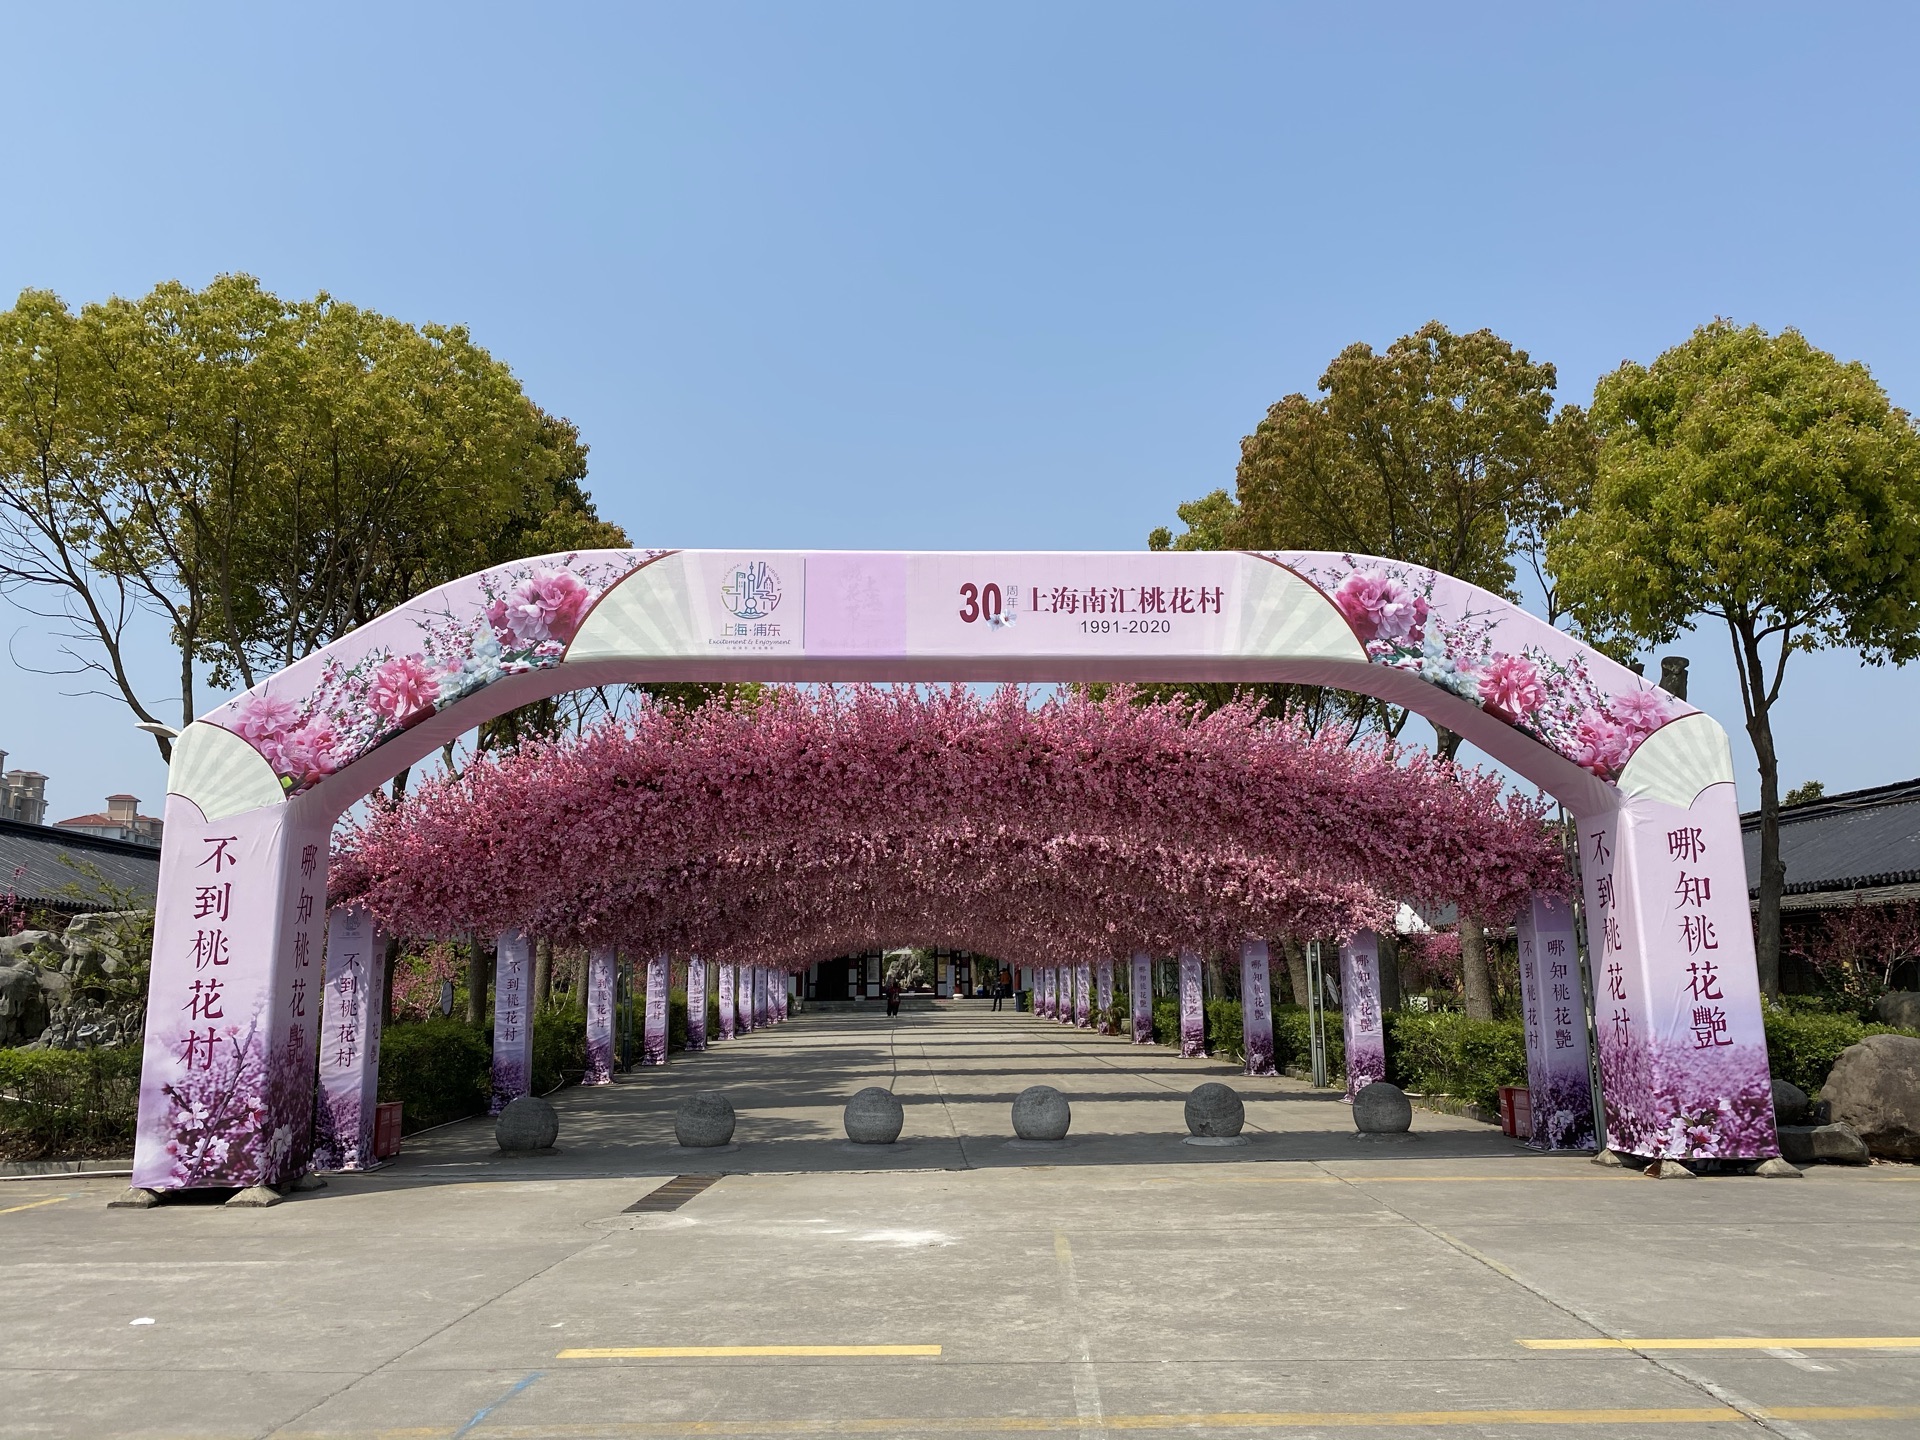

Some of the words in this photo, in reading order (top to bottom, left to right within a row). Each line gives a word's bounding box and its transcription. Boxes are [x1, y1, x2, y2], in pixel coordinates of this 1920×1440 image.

[959, 582, 1001, 623] 30
[1006, 584, 1018, 609] 周年
[1024, 586, 1225, 614] 上海南汇桃花村
[1080, 619, 1171, 634] 1991-2020
[755, 638, 791, 646] Enjoyment
[176, 835, 238, 1071] 不到桃花村
[1590, 830, 1631, 1048] 不到桃花村
[336, 952, 360, 1068] 不到桃花村
[503, 961, 521, 1042] 不到桃花村
[1523, 940, 1539, 1050] 不到桃花村
